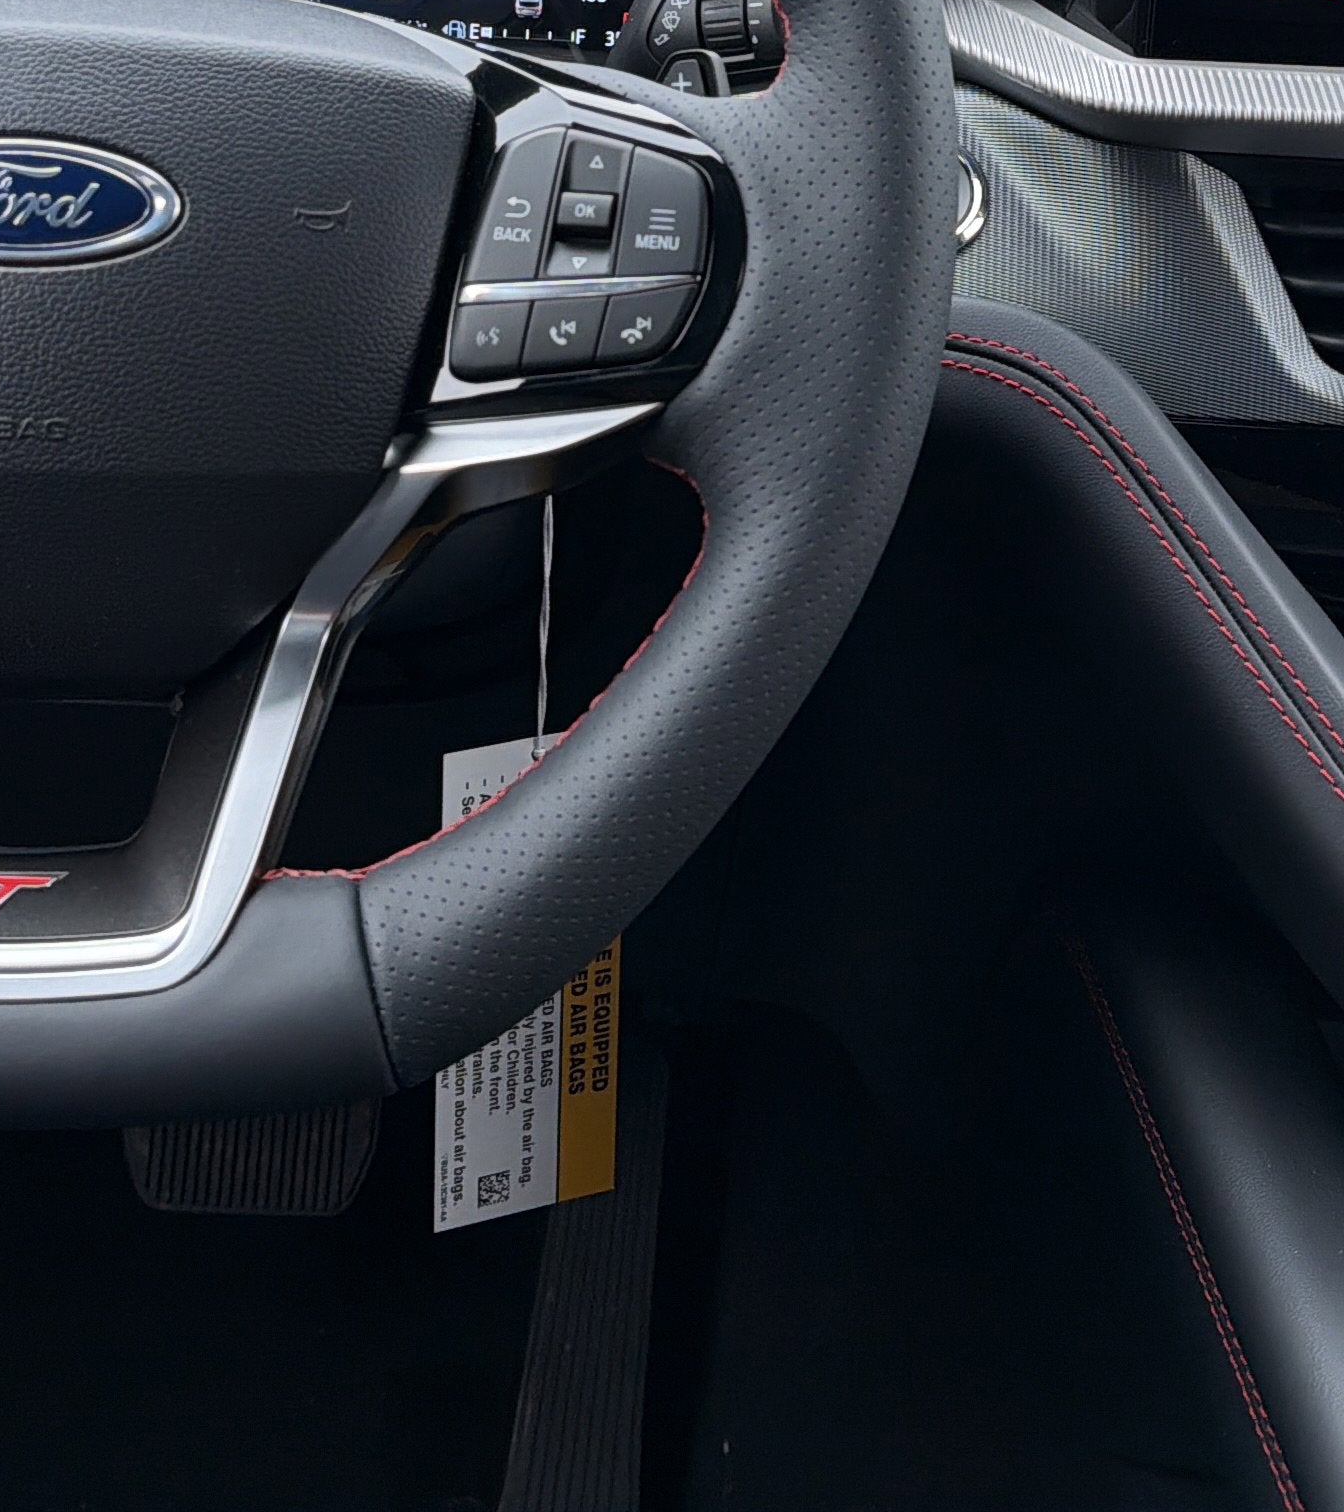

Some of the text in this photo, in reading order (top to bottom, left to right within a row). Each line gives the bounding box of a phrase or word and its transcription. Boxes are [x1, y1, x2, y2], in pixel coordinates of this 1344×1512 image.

[469, 23, 587, 44] E F
[574, 203, 596, 219] OK
[493, 226, 531, 243] BACK
[635, 233, 680, 251] MENU
[595, 968, 612, 988] IS
[569, 1004, 586, 1037] AIR
[540, 1021, 554, 1045] AIR
[590, 993, 611, 1092] EQUIPPED
[488, 1050, 502, 1073] the
[521, 1034, 536, 1083] injured
[539, 1051, 553, 1088] BAGS
[568, 1044, 585, 1095] BAGS
[505, 1050, 519, 1115] Children.
[487, 1077, 502, 1115] front.
[520, 1088, 535, 1104] by
[453, 1100, 467, 1140] about
[522, 1109, 535, 1131] the
[453, 1144, 466, 1163] air
[521, 1135, 534, 1154] air
[518, 1158, 533, 1188] bag.
[450, 1167, 466, 1206] bags.
